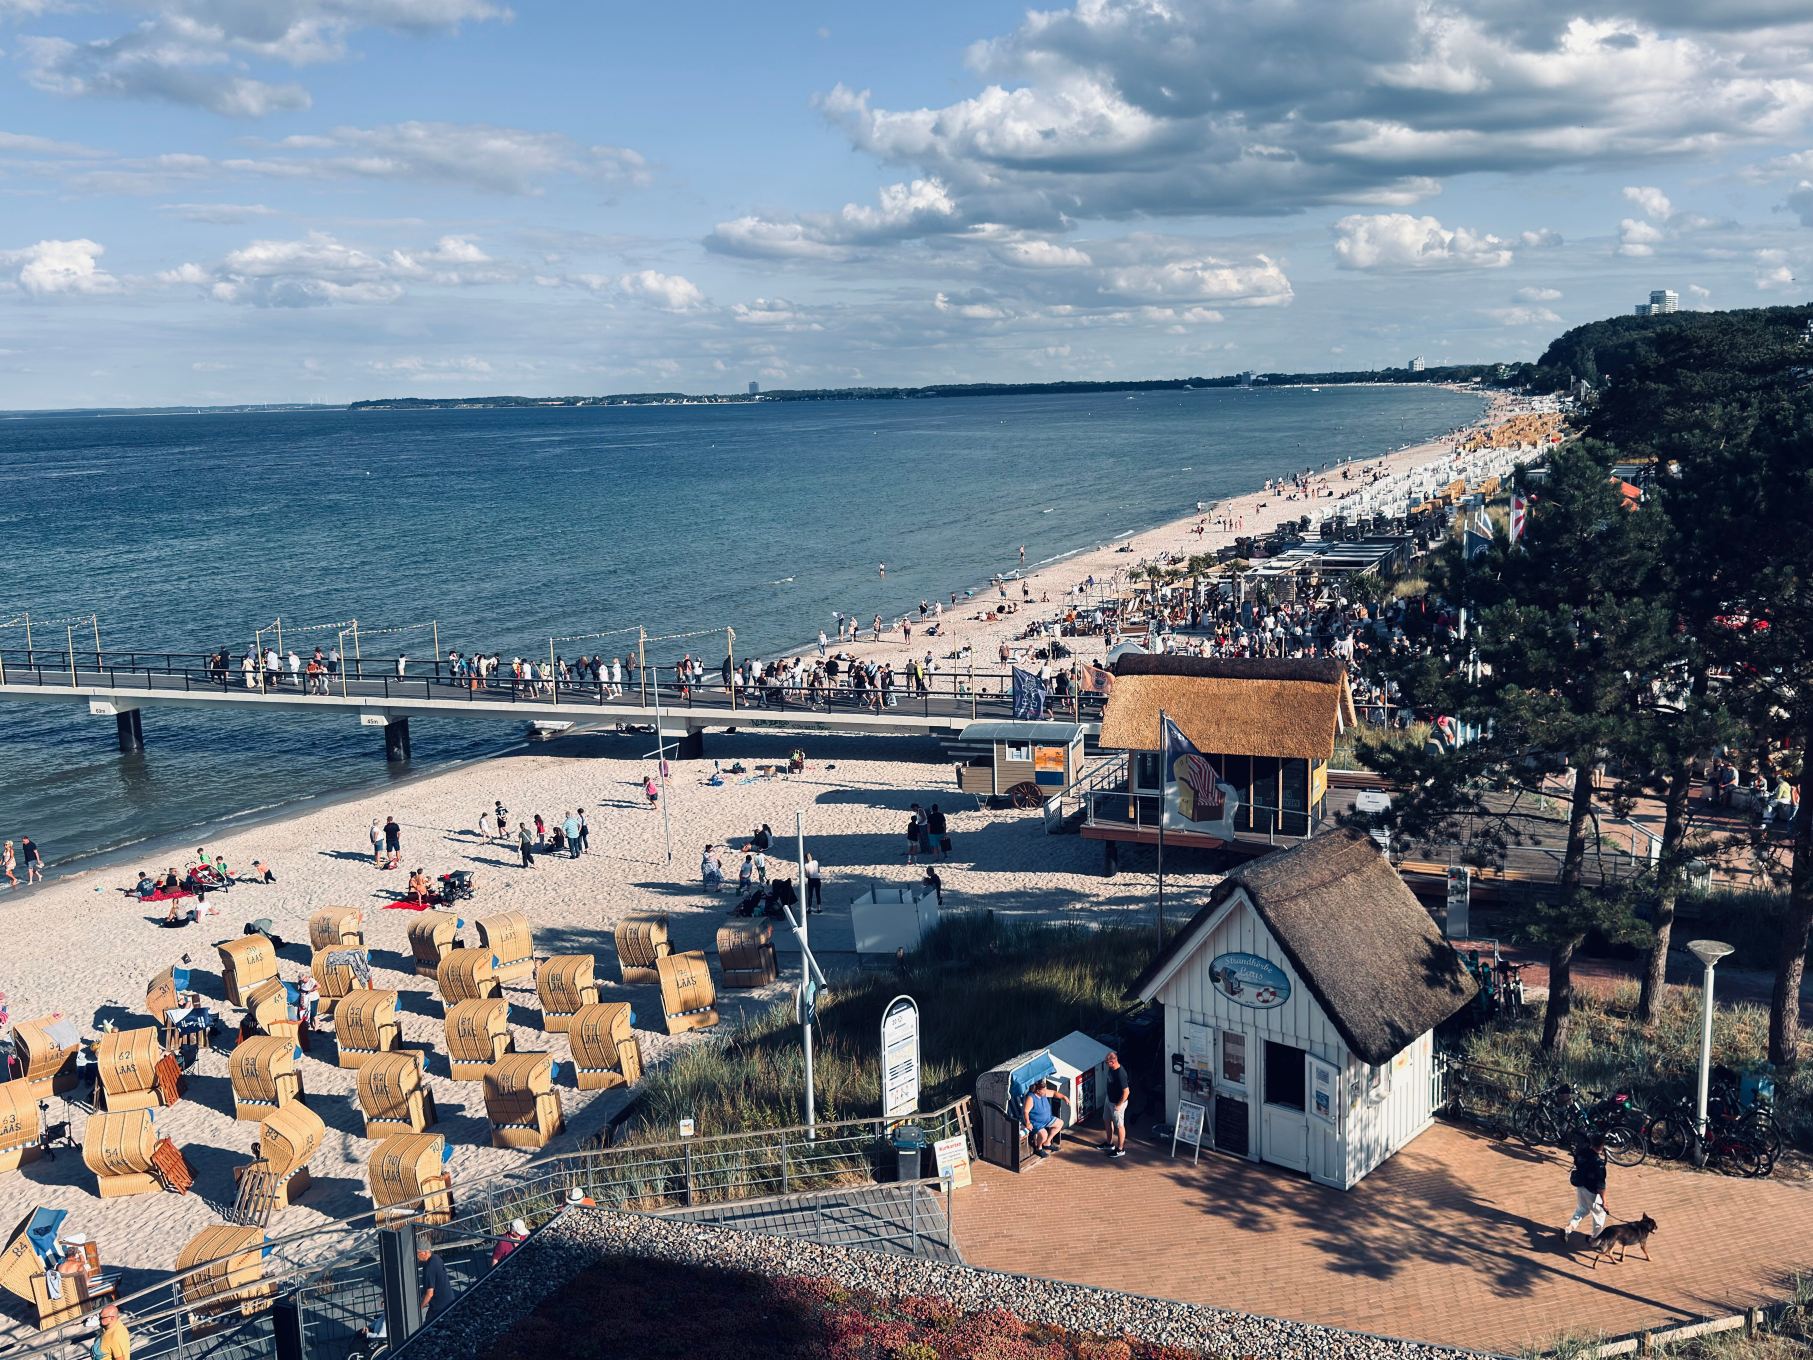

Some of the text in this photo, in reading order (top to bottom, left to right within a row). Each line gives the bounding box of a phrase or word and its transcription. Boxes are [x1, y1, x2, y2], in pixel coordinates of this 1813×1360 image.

[678, 976, 697, 988] LAAS
[119, 1051, 131, 1060] 62
[266, 1126, 279, 1140] 83
[105, 1148, 118, 1158] 54
[12, 1241, 28, 1258] 84
